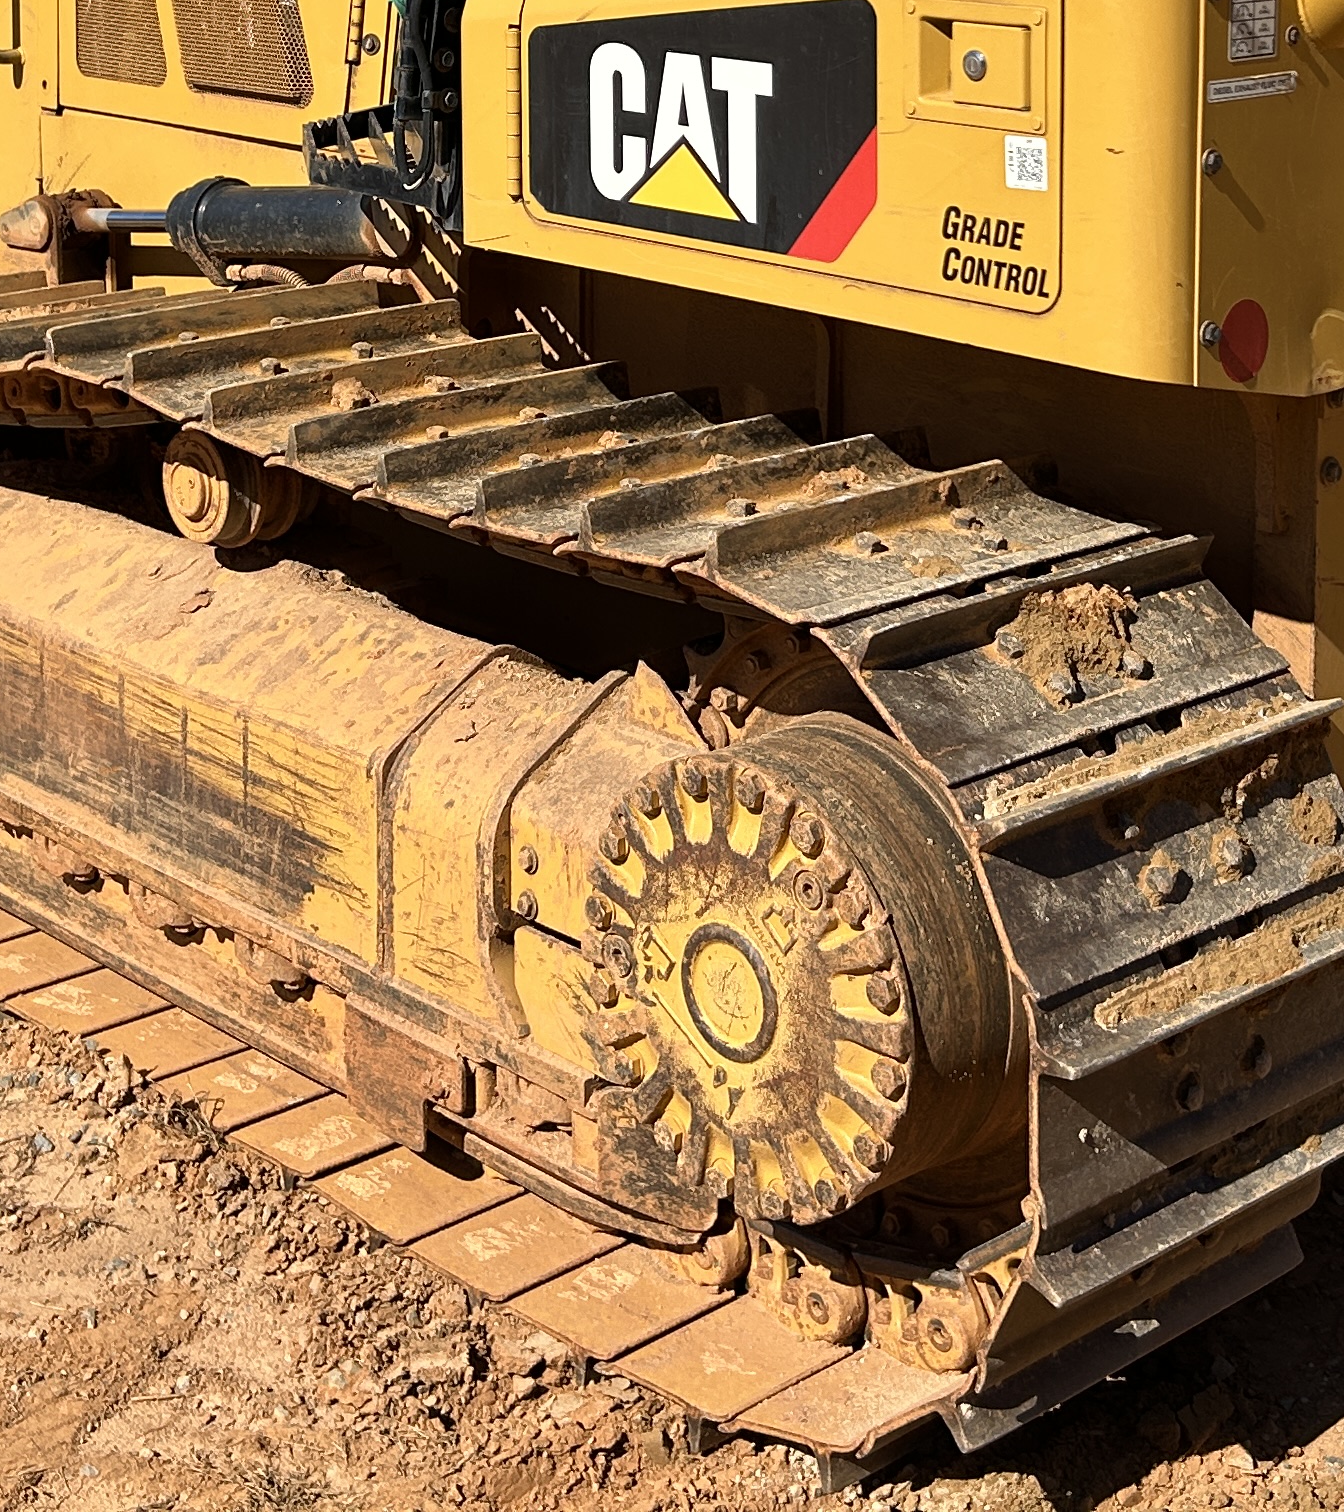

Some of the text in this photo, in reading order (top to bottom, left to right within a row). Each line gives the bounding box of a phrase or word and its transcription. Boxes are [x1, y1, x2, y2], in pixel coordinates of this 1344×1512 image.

[589, 40, 774, 225] CAT
[942, 205, 1026, 251] GRADE
[942, 246, 1050, 299] CONTROL
